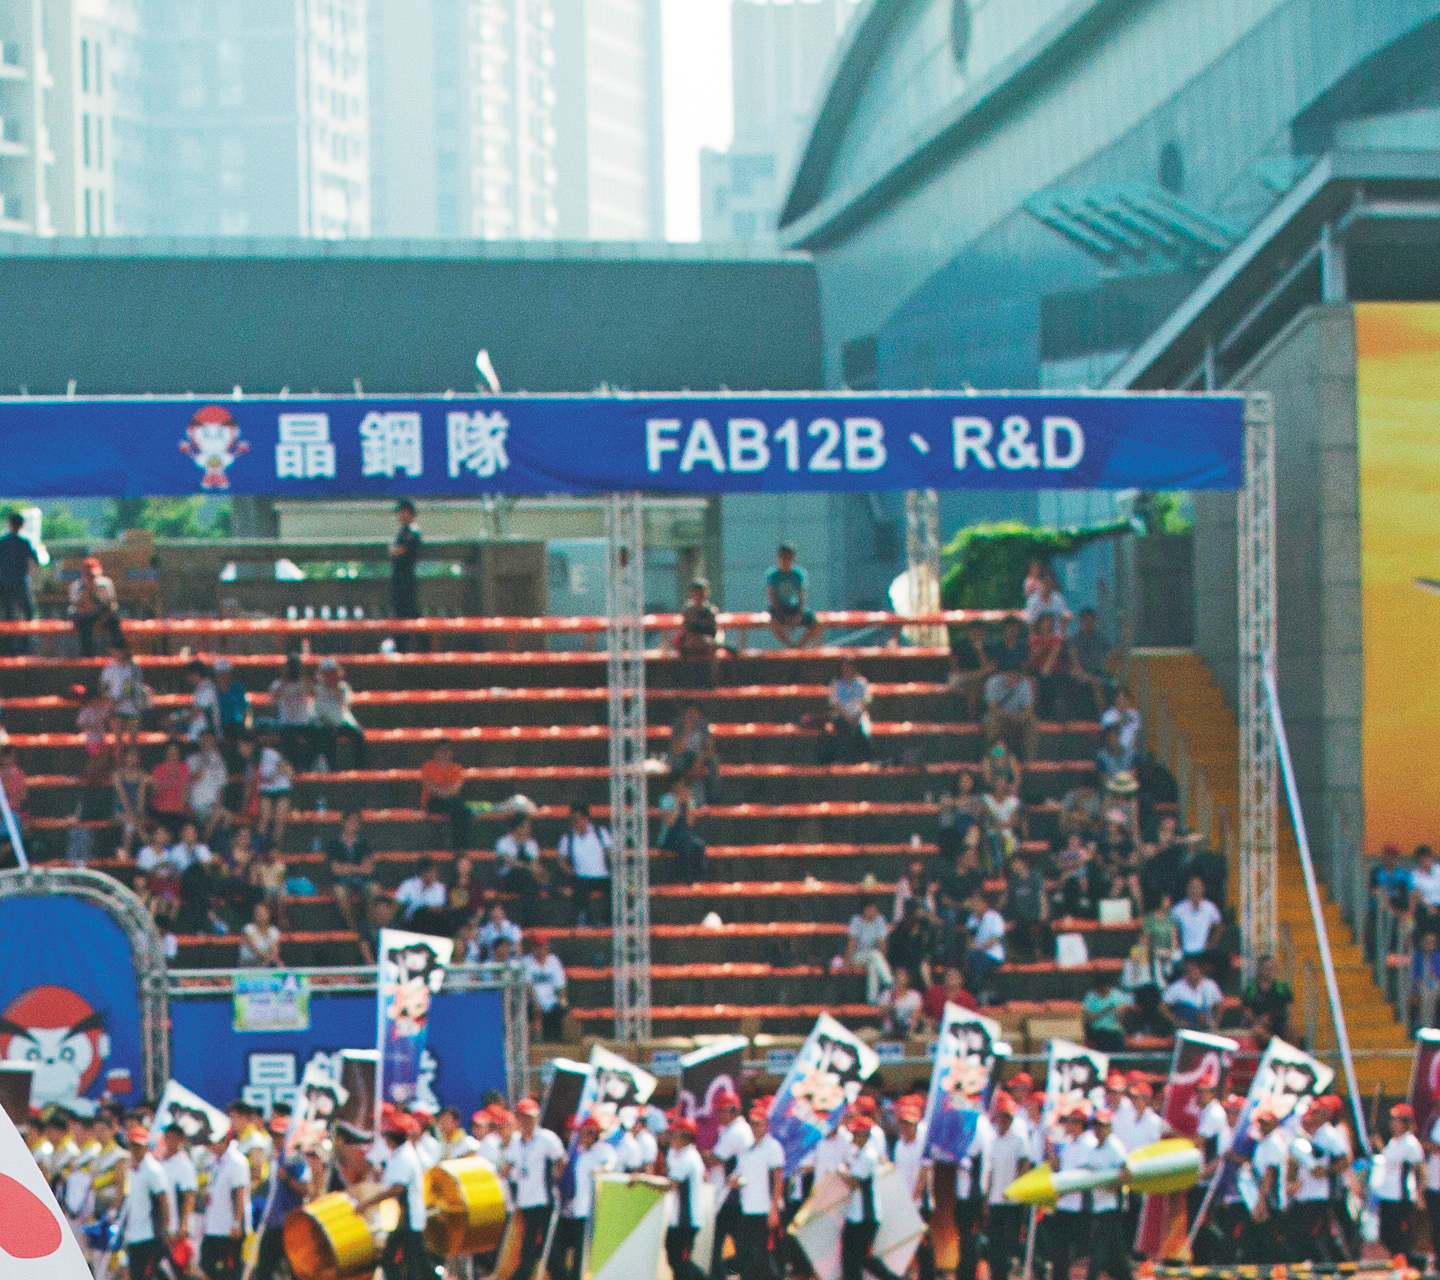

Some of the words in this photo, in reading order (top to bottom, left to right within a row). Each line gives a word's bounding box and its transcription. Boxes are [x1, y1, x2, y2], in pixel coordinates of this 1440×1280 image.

[273, 411, 511, 479] 晶鋼隊
[645, 417, 888, 473] FAB12B
[951, 415, 1086, 471] R&D
